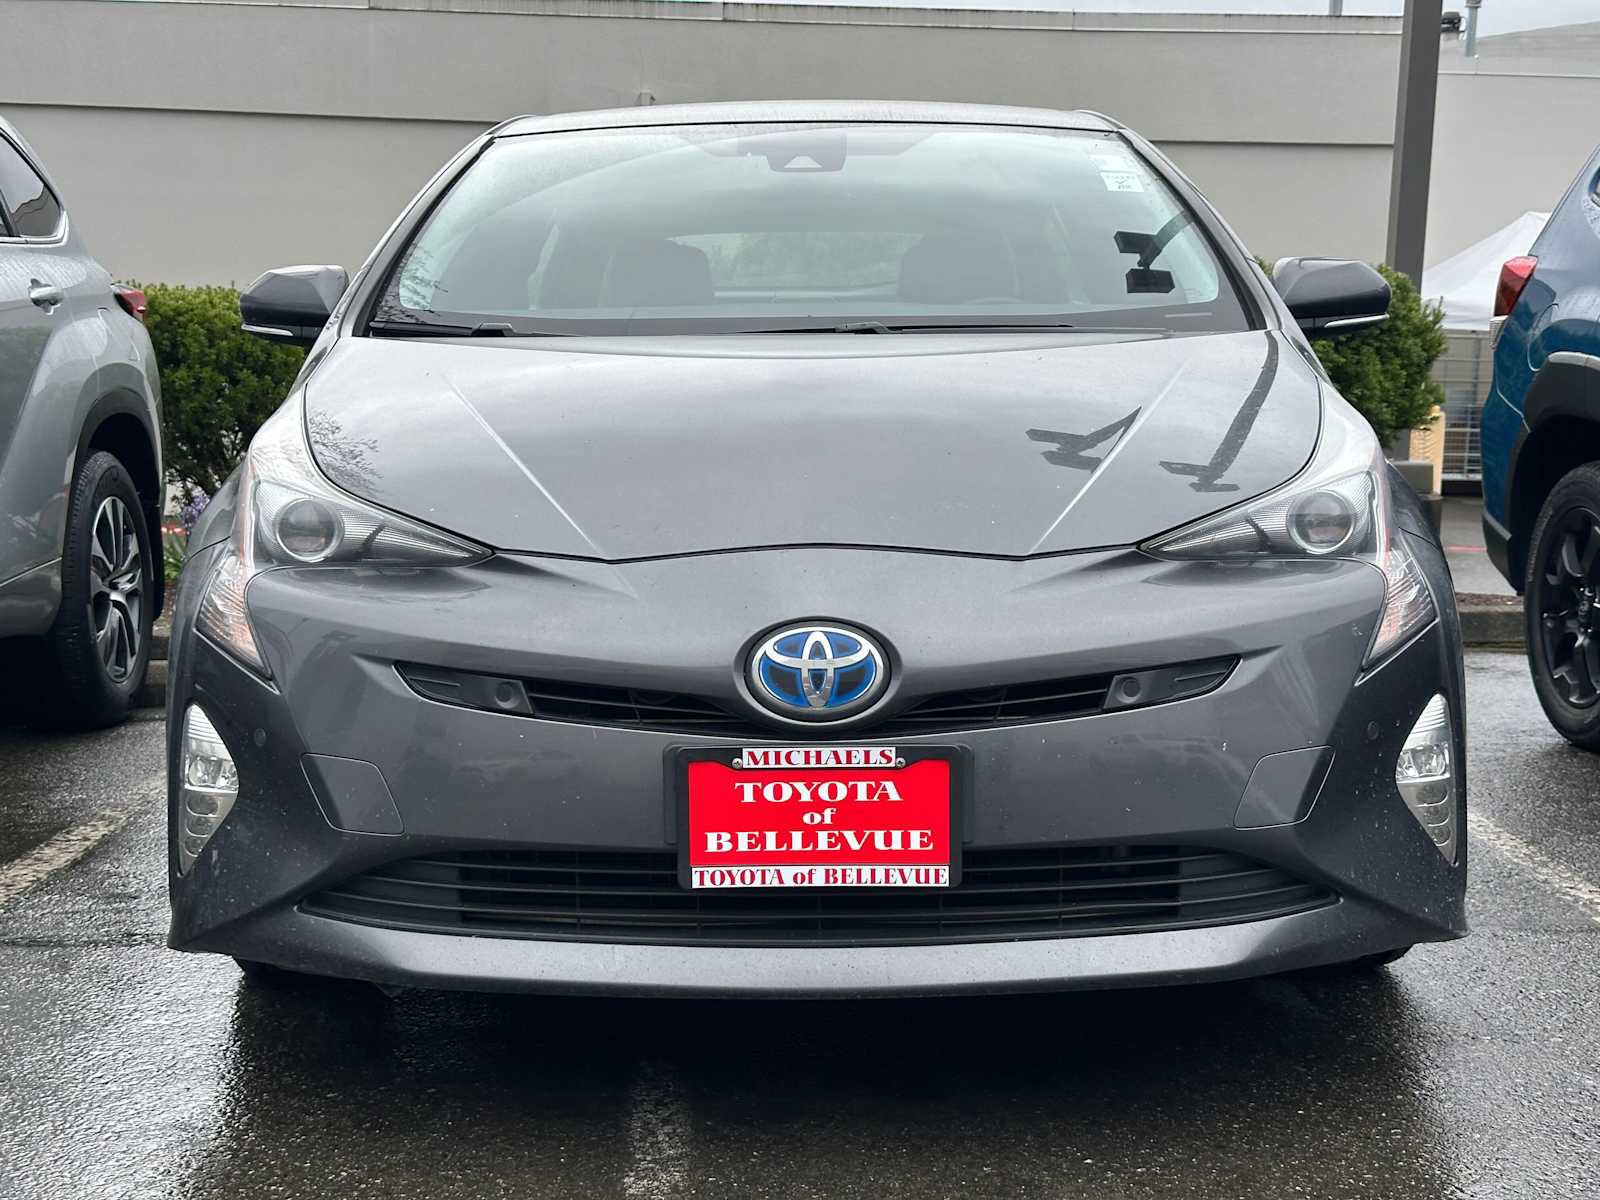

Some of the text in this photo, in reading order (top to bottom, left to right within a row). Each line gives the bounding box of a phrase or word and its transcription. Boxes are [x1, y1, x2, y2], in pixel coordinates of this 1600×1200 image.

[746, 749, 893, 766] MICHAELS
[735, 781, 903, 803] TOYOTA
[802, 808, 836, 825] of
[704, 830, 934, 852] BELLEVUE
[694, 868, 946, 886] TOYOTA of BELLEVUE
